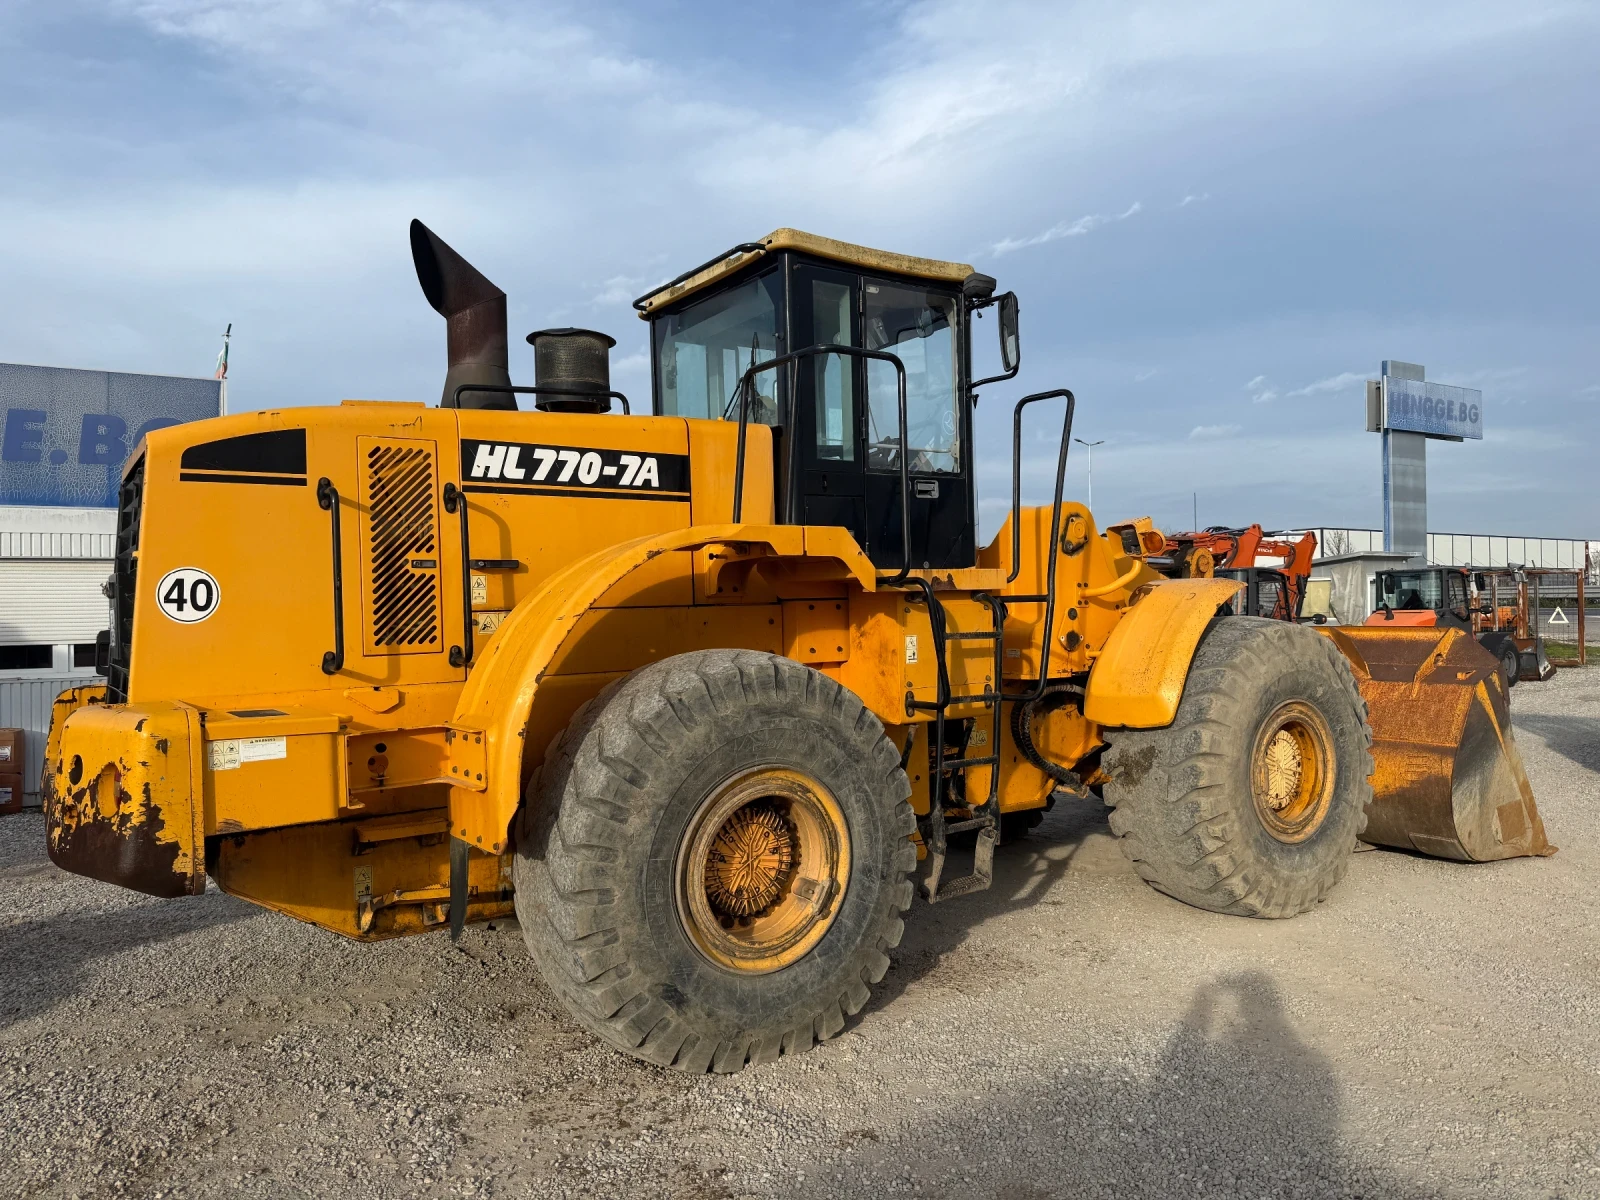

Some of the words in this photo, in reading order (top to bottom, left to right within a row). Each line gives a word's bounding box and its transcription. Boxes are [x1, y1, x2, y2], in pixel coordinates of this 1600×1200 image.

[470, 444, 526, 480] HL
[532, 448, 660, 487] 770-7A
[163, 578, 214, 612] 40
